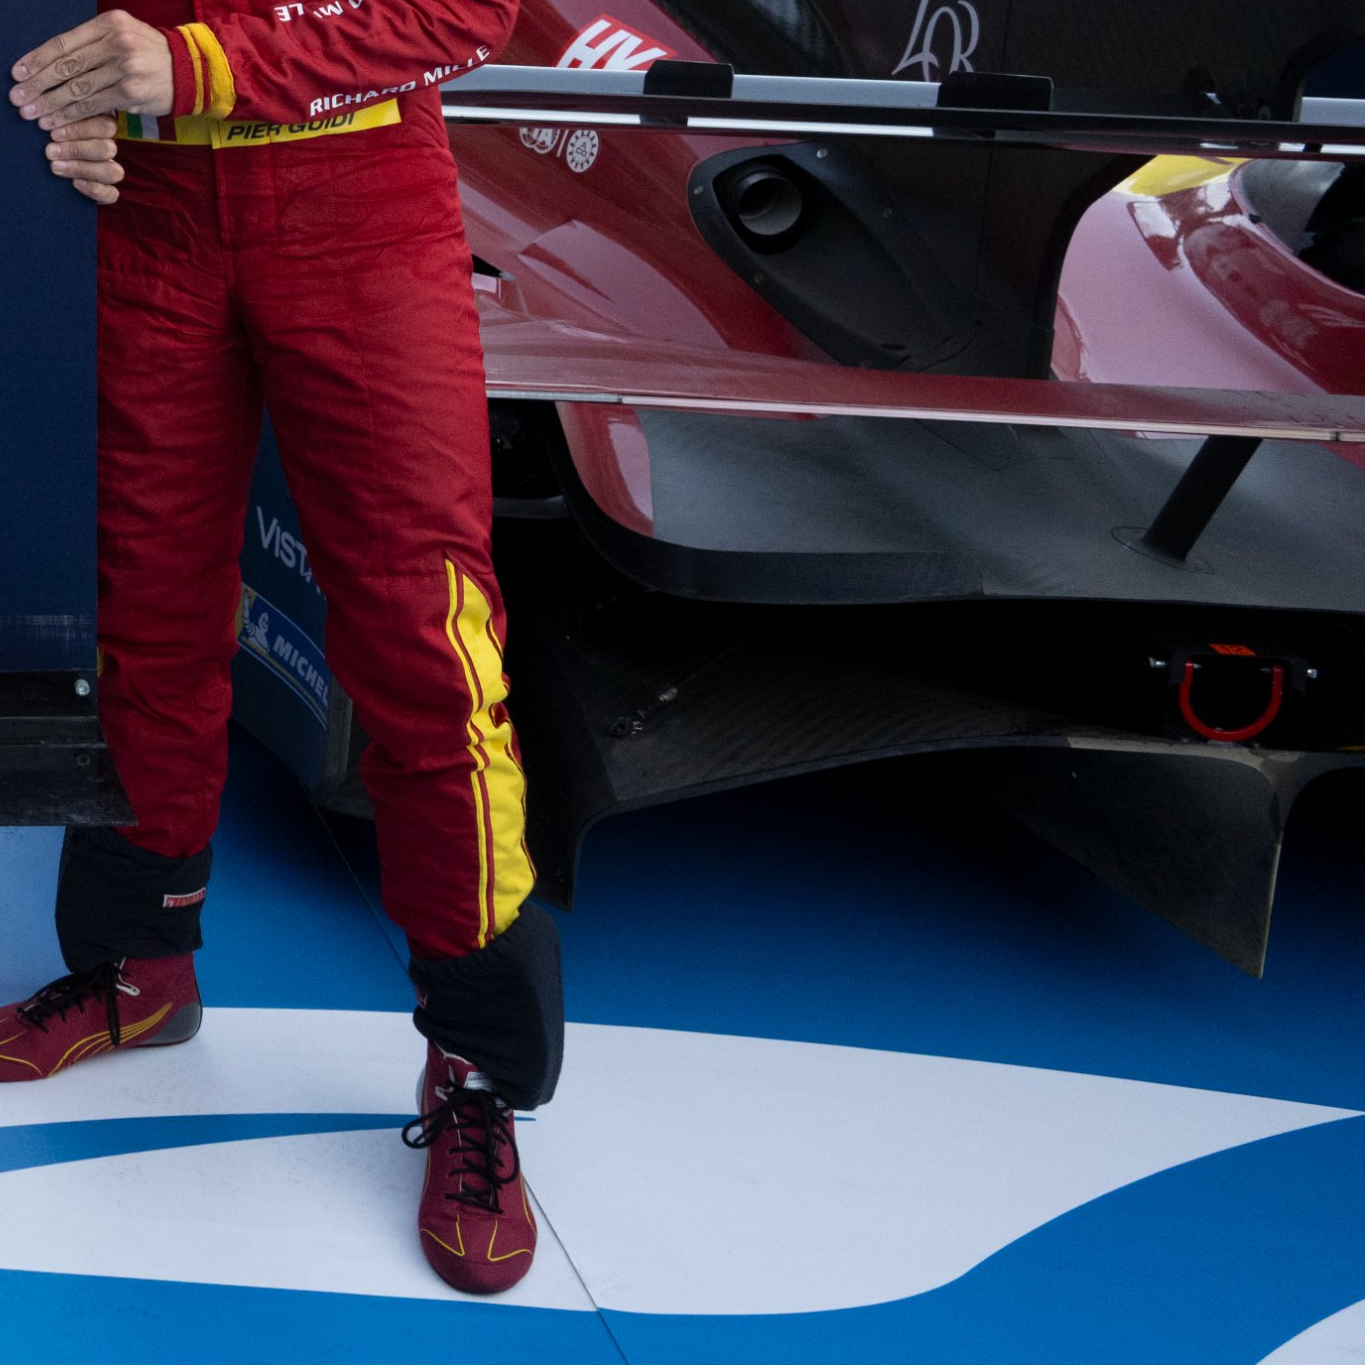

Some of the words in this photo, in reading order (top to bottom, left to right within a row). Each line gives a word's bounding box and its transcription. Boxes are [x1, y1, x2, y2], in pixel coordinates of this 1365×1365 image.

[310, 80, 417, 117] RICHARD
[227, 124, 282, 140] PIER
[273, 634, 328, 708] MICHEL
